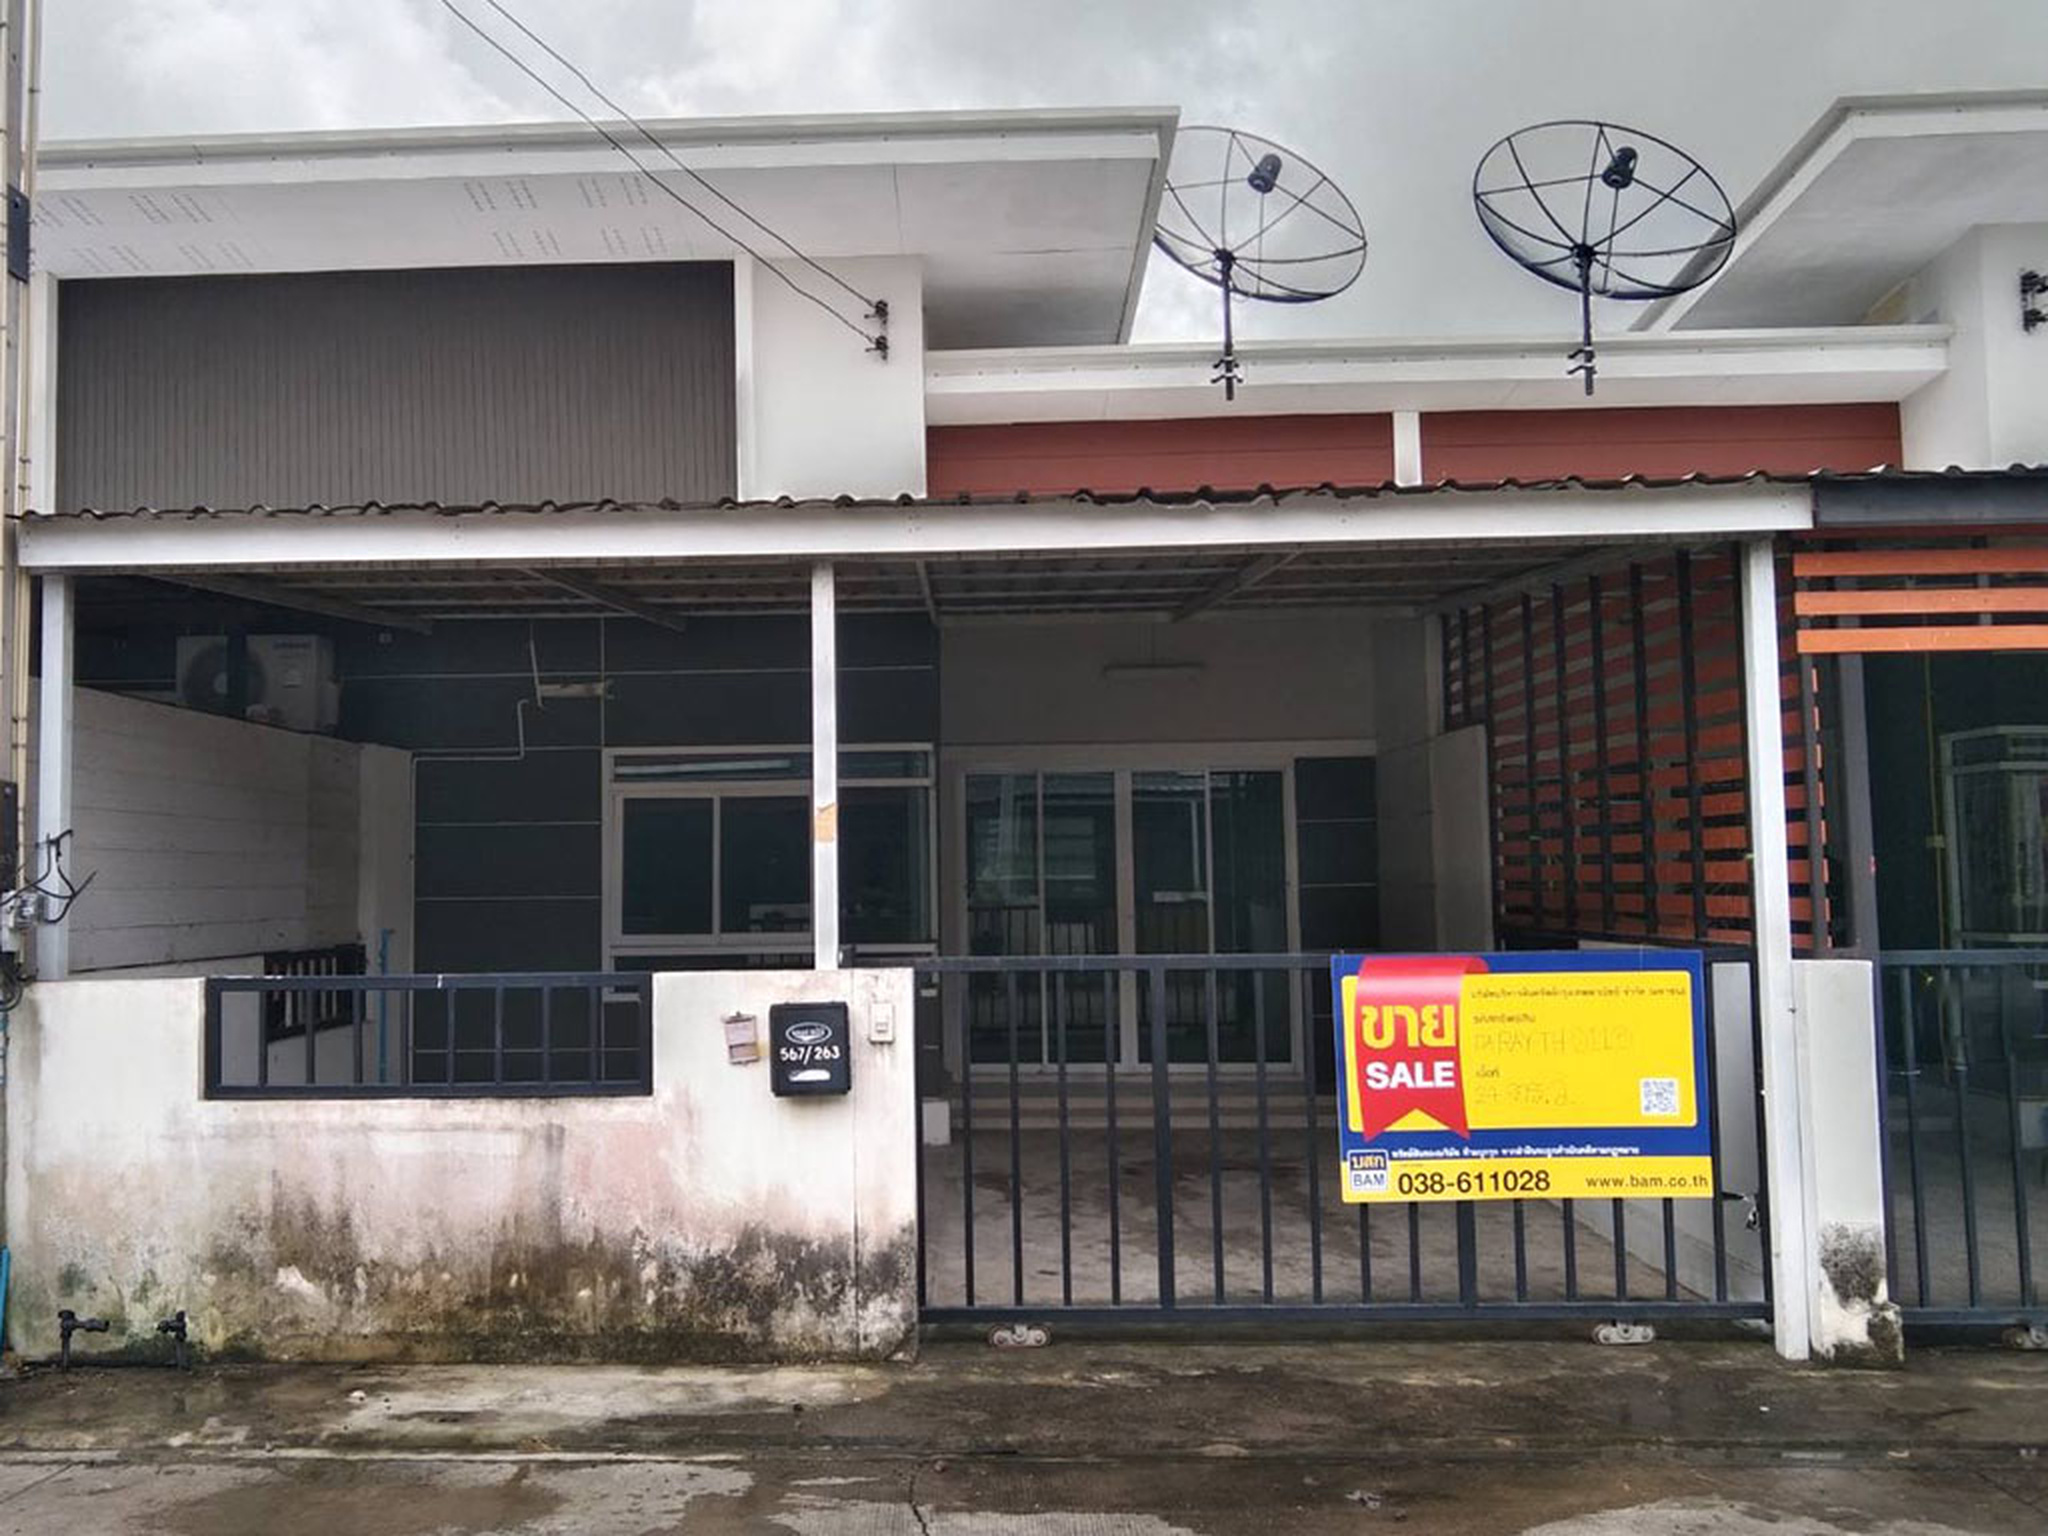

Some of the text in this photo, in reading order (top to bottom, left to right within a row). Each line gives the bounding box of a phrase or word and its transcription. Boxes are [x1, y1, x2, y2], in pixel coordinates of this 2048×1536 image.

[1361, 1004, 1456, 1048] ขาย
[780, 1045, 840, 1065] 567/263
[1366, 1061, 1456, 1091] SALE
[1353, 1173, 1385, 1187] BAM
[1398, 1169, 1550, 1195] 038-611028
[1585, 1170, 1709, 1190] www.bam.co.th
